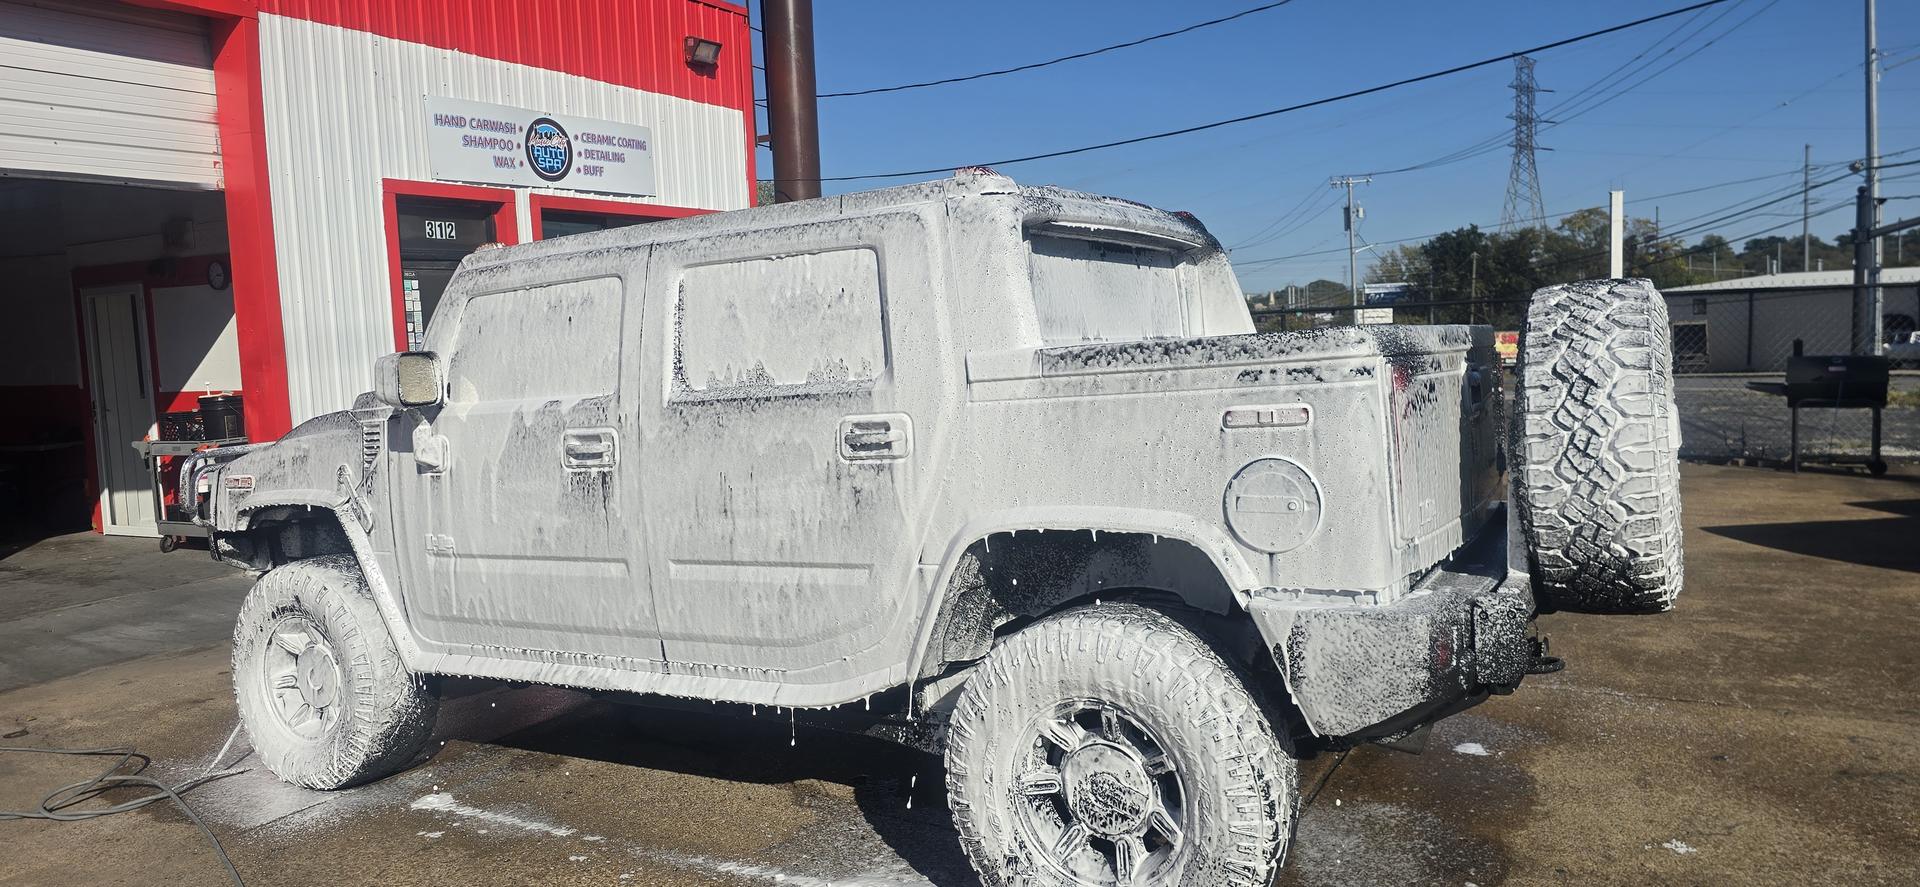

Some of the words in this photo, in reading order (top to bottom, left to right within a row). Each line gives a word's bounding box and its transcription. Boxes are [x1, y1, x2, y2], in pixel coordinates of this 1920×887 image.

[433, 113, 467, 128] HAND
[468, 117, 517, 134] CARWASH
[462, 135, 514, 150] SHAMPOO
[580, 132, 616, 147] CERAMIC
[617, 136, 647, 151] COATING
[534, 147, 565, 159] AUTO
[584, 149, 625, 163] DETAILING
[493, 155, 516, 169] WAX
[538, 158, 562, 170] SPA
[583, 165, 604, 177] BUFF
[427, 221, 455, 239] 312
